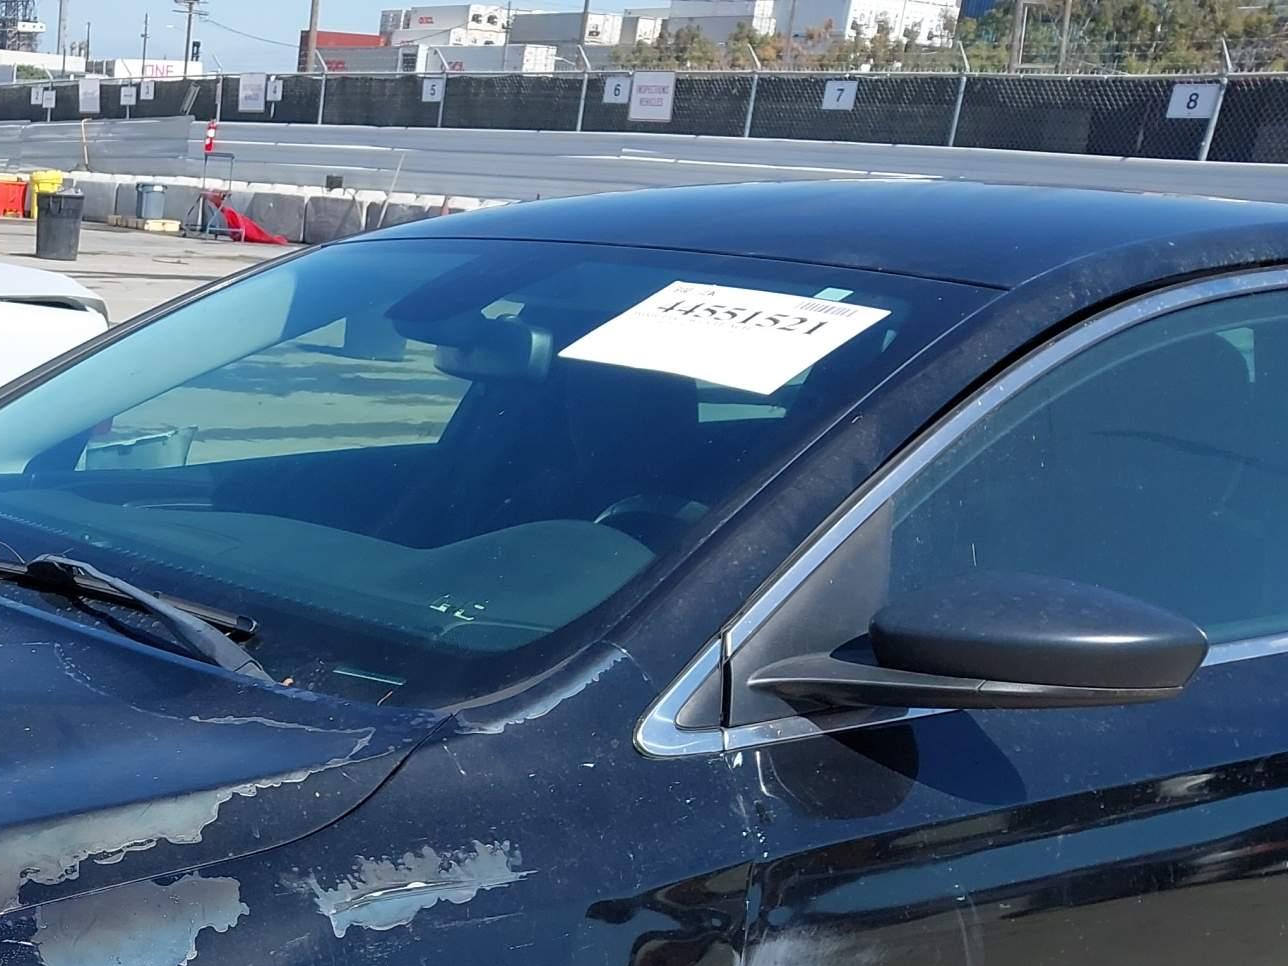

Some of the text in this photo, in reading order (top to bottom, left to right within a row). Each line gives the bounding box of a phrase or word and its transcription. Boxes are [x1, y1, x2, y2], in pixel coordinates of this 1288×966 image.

[429, 84, 436, 96] 5
[613, 84, 621, 97] 6
[836, 88, 845, 103] 7
[1186, 92, 1199, 110] 8
[657, 300, 828, 335] 44551521
